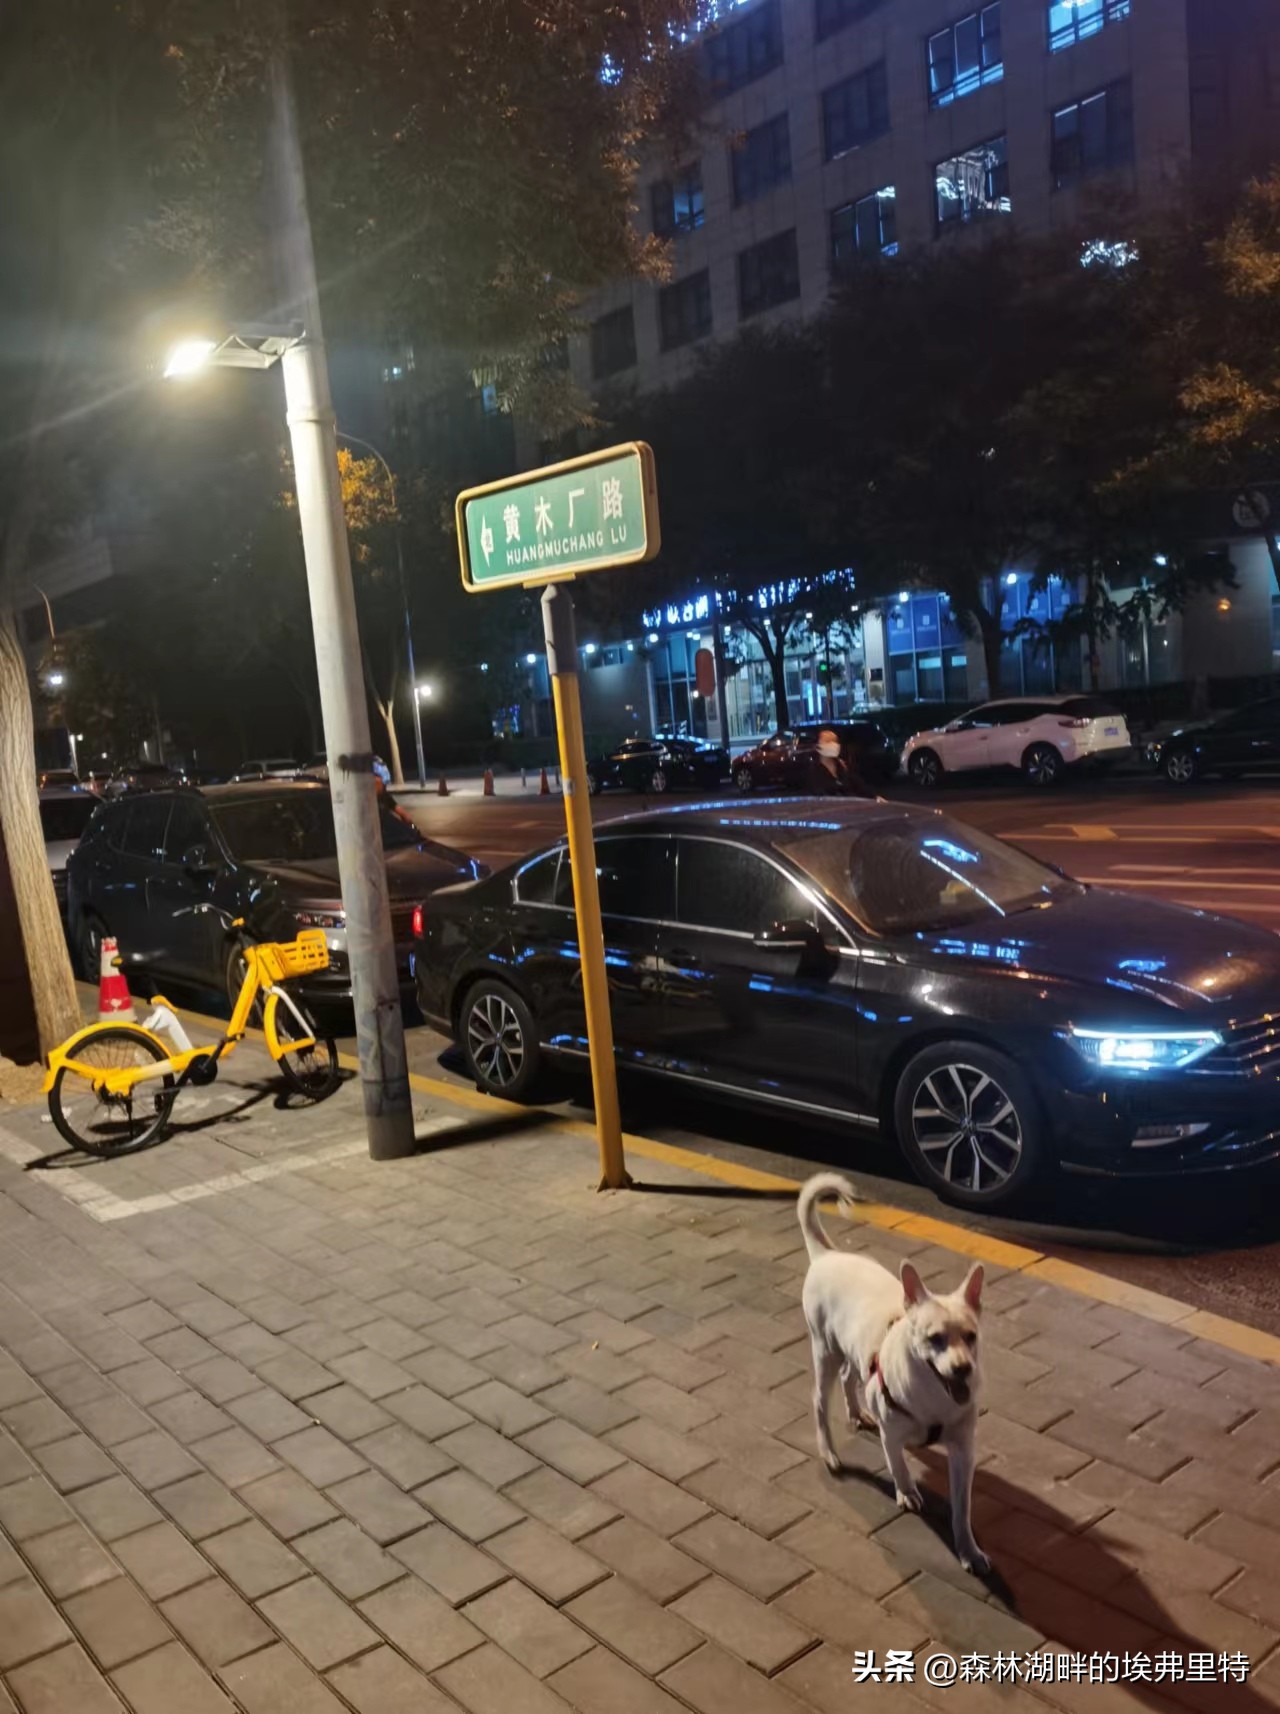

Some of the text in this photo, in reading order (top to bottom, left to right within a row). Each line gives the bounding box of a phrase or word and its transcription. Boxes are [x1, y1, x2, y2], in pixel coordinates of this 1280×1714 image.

[503, 477, 623, 544] 黄木厂路
[506, 531, 604, 566] HUANGMUCHANG
[611, 524, 627, 545] LU
